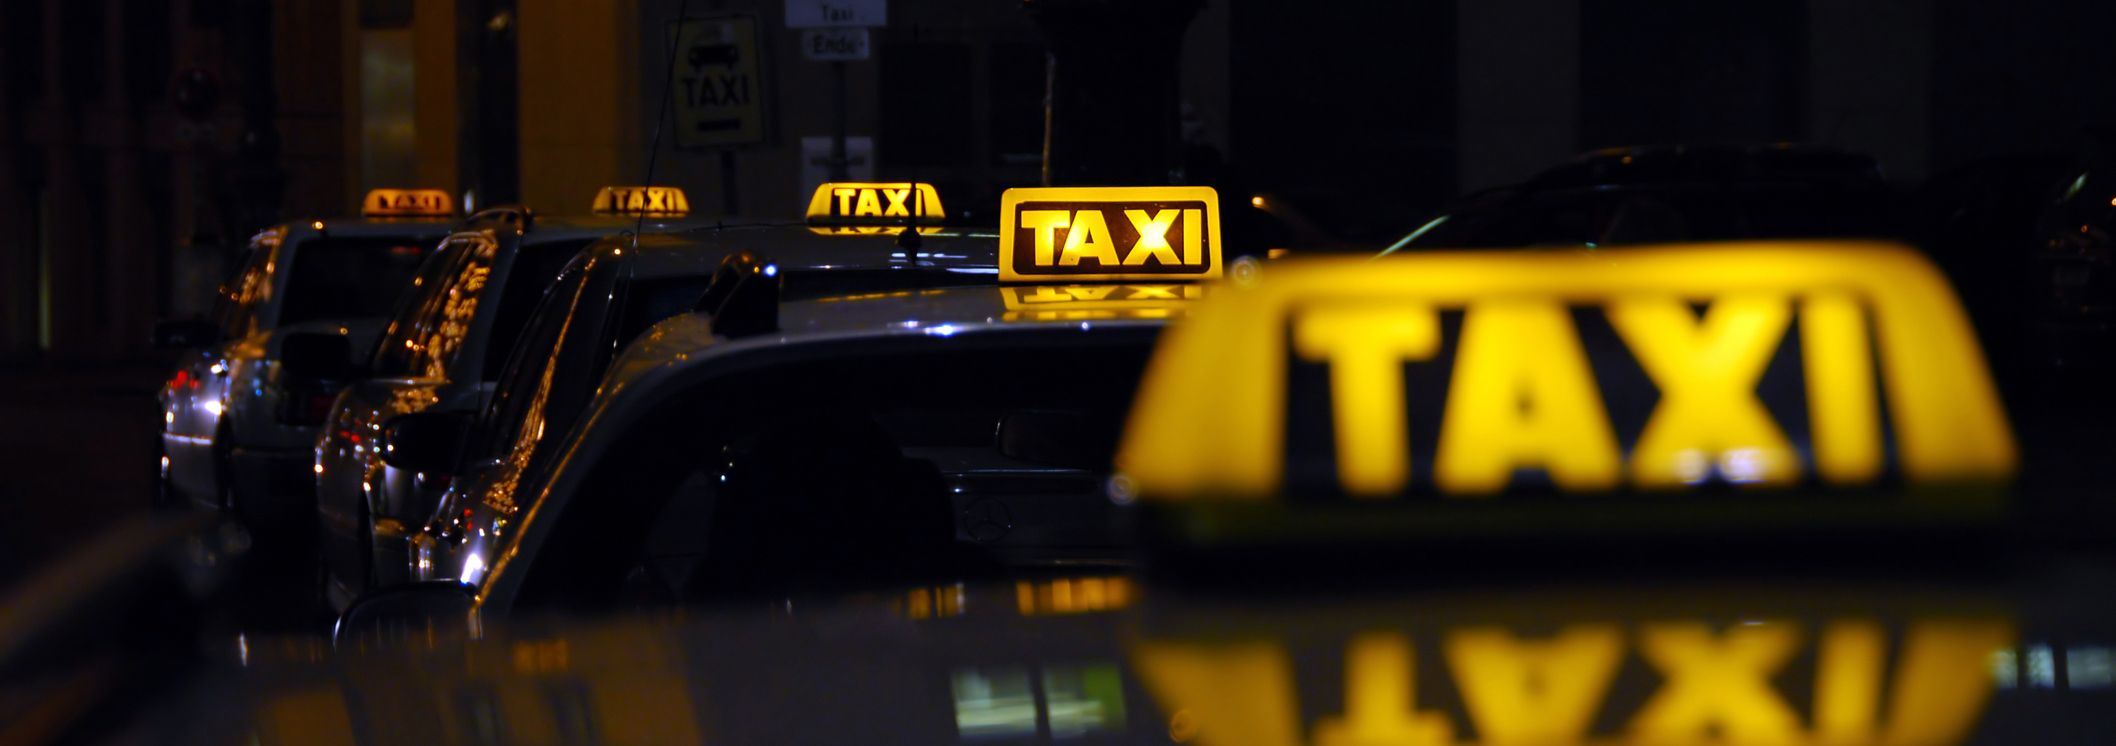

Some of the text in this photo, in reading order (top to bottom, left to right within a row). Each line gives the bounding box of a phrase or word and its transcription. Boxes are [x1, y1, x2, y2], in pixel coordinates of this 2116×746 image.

[821, 5, 853, 20] Taxi
[682, 75, 750, 107] TAXI
[610, 189, 675, 211] TAXI
[833, 188, 923, 217] TAXI
[1020, 208, 1203, 267] TAXI
[1292, 296, 1882, 494] TAXI
